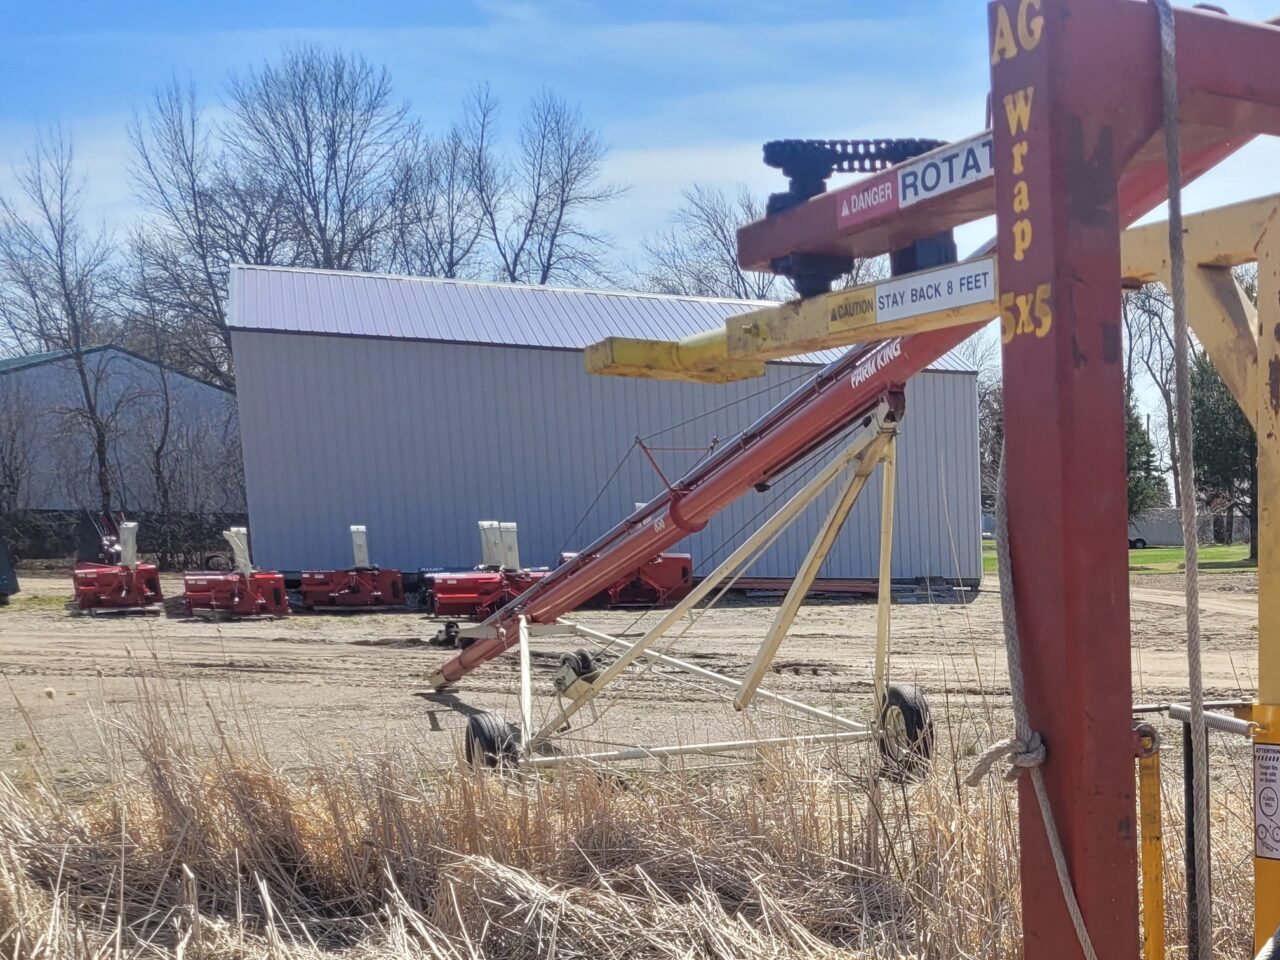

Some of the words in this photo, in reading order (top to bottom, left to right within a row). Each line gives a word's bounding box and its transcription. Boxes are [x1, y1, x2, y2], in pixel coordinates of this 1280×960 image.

[991, 0, 1044, 65] AG
[1003, 86, 1035, 262] Wrap
[851, 181, 893, 214] DANGER
[837, 298, 874, 320] CAUTION
[878, 290, 906, 310] STAY
[910, 282, 942, 303] BACK
[946, 280, 953, 296] 8
[959, 271, 989, 293] FEET
[851, 355, 877, 390] FARM
[876, 336, 902, 370] KING
